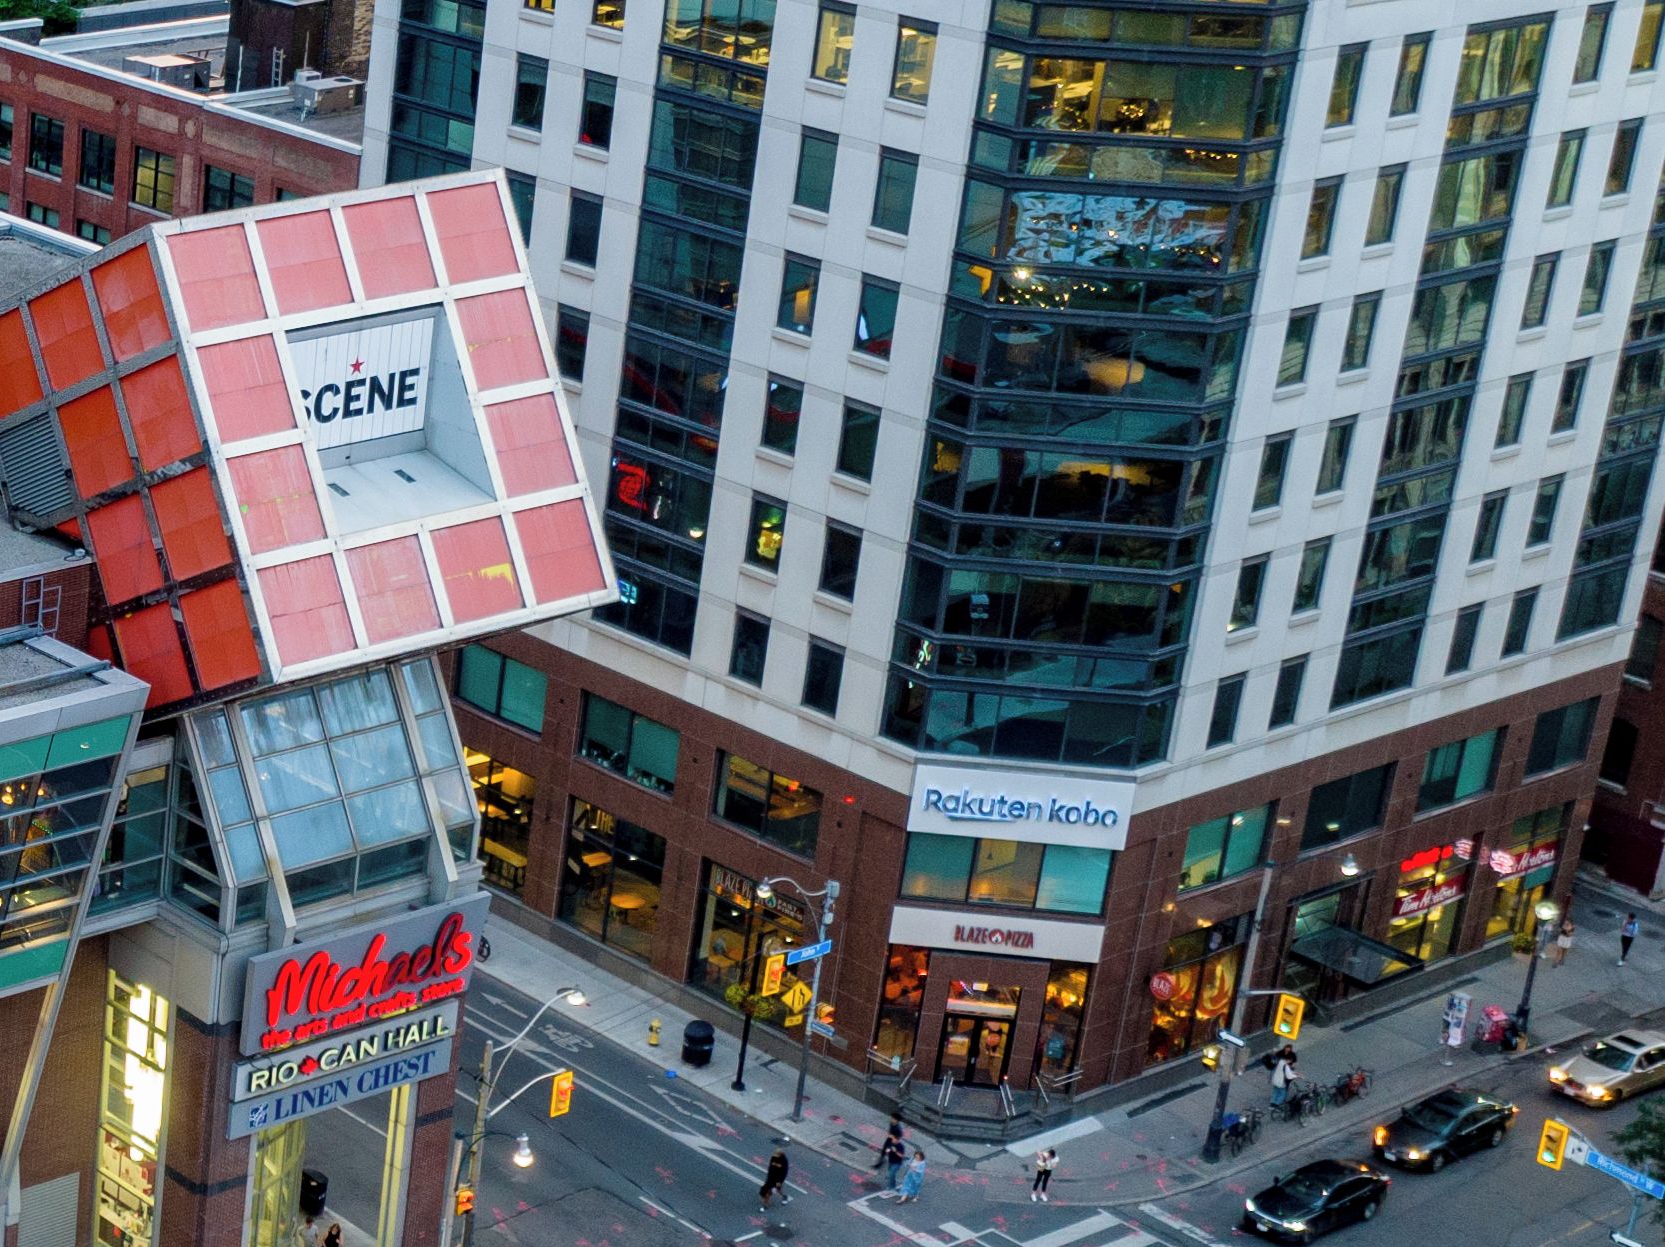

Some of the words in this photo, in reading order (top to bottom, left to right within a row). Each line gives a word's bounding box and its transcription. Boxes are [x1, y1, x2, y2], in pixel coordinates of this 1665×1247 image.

[923, 787, 1042, 821] Rakuten
[1049, 798, 1119, 828] kobo
[1399, 894, 1418, 914] Tim
[954, 924, 988, 944] BLAZE
[1005, 930, 1033, 949] PIZZA
[265, 912, 473, 1027] Michaels
[249, 1062, 298, 1093] RIO
[319, 1036, 378, 1072] CAN
[386, 1015, 449, 1050] HALL
[274, 1077, 352, 1121] LINEN
[357, 1051, 436, 1095] CHEST
